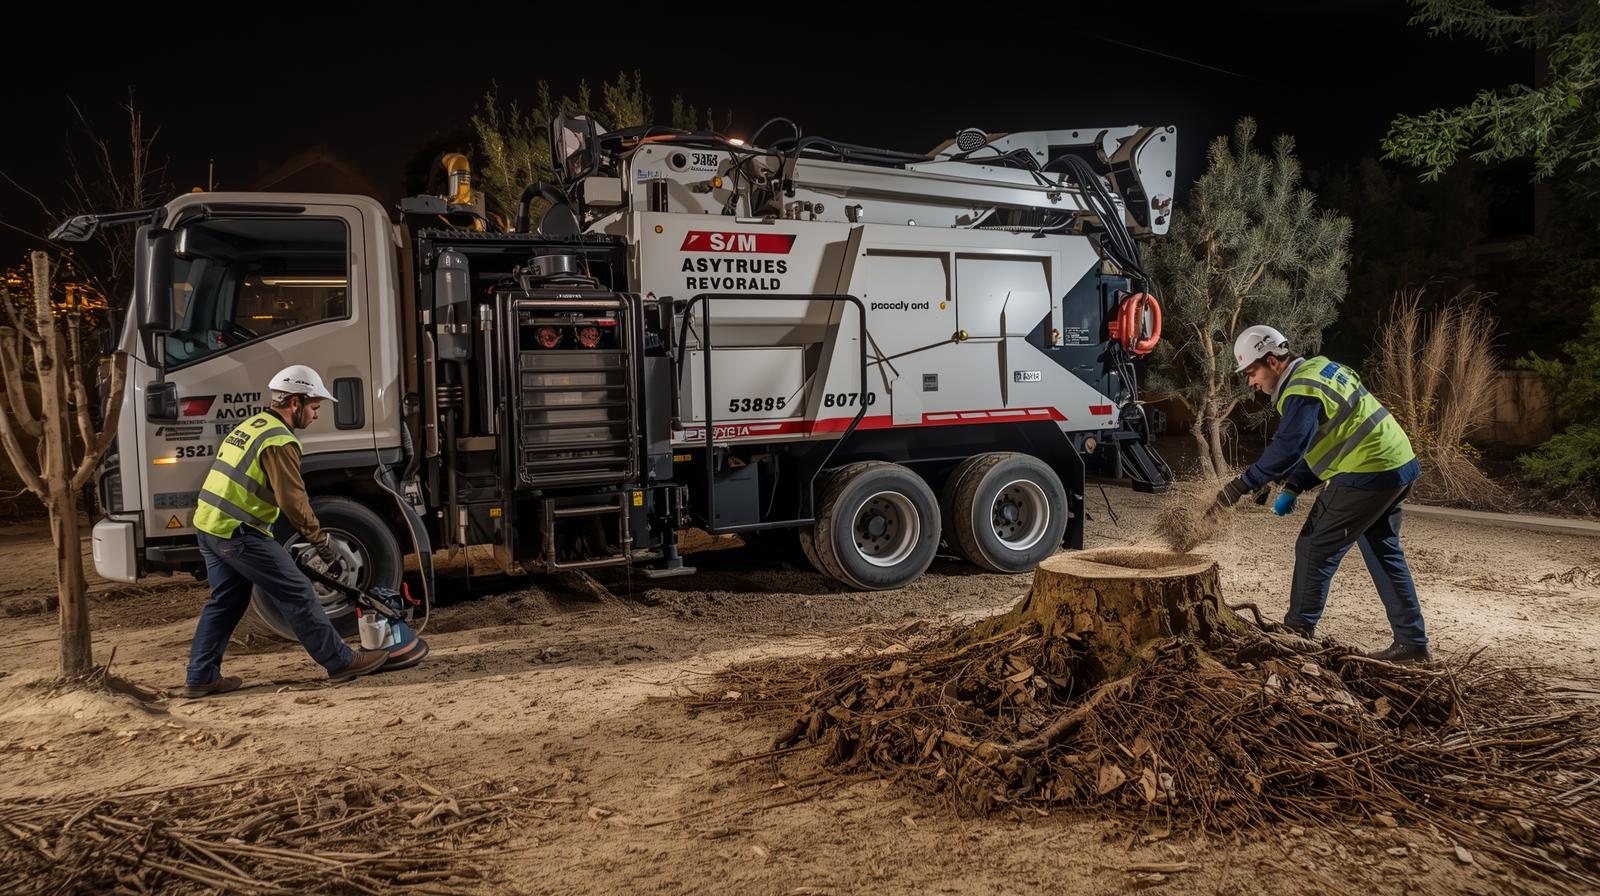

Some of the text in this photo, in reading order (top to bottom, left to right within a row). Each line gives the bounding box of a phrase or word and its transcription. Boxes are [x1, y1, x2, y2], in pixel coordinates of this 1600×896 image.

[681, 257, 788, 274] ASYTRUES
[686, 276, 781, 291] REVORALD
[729, 396, 786, 412] 53895
